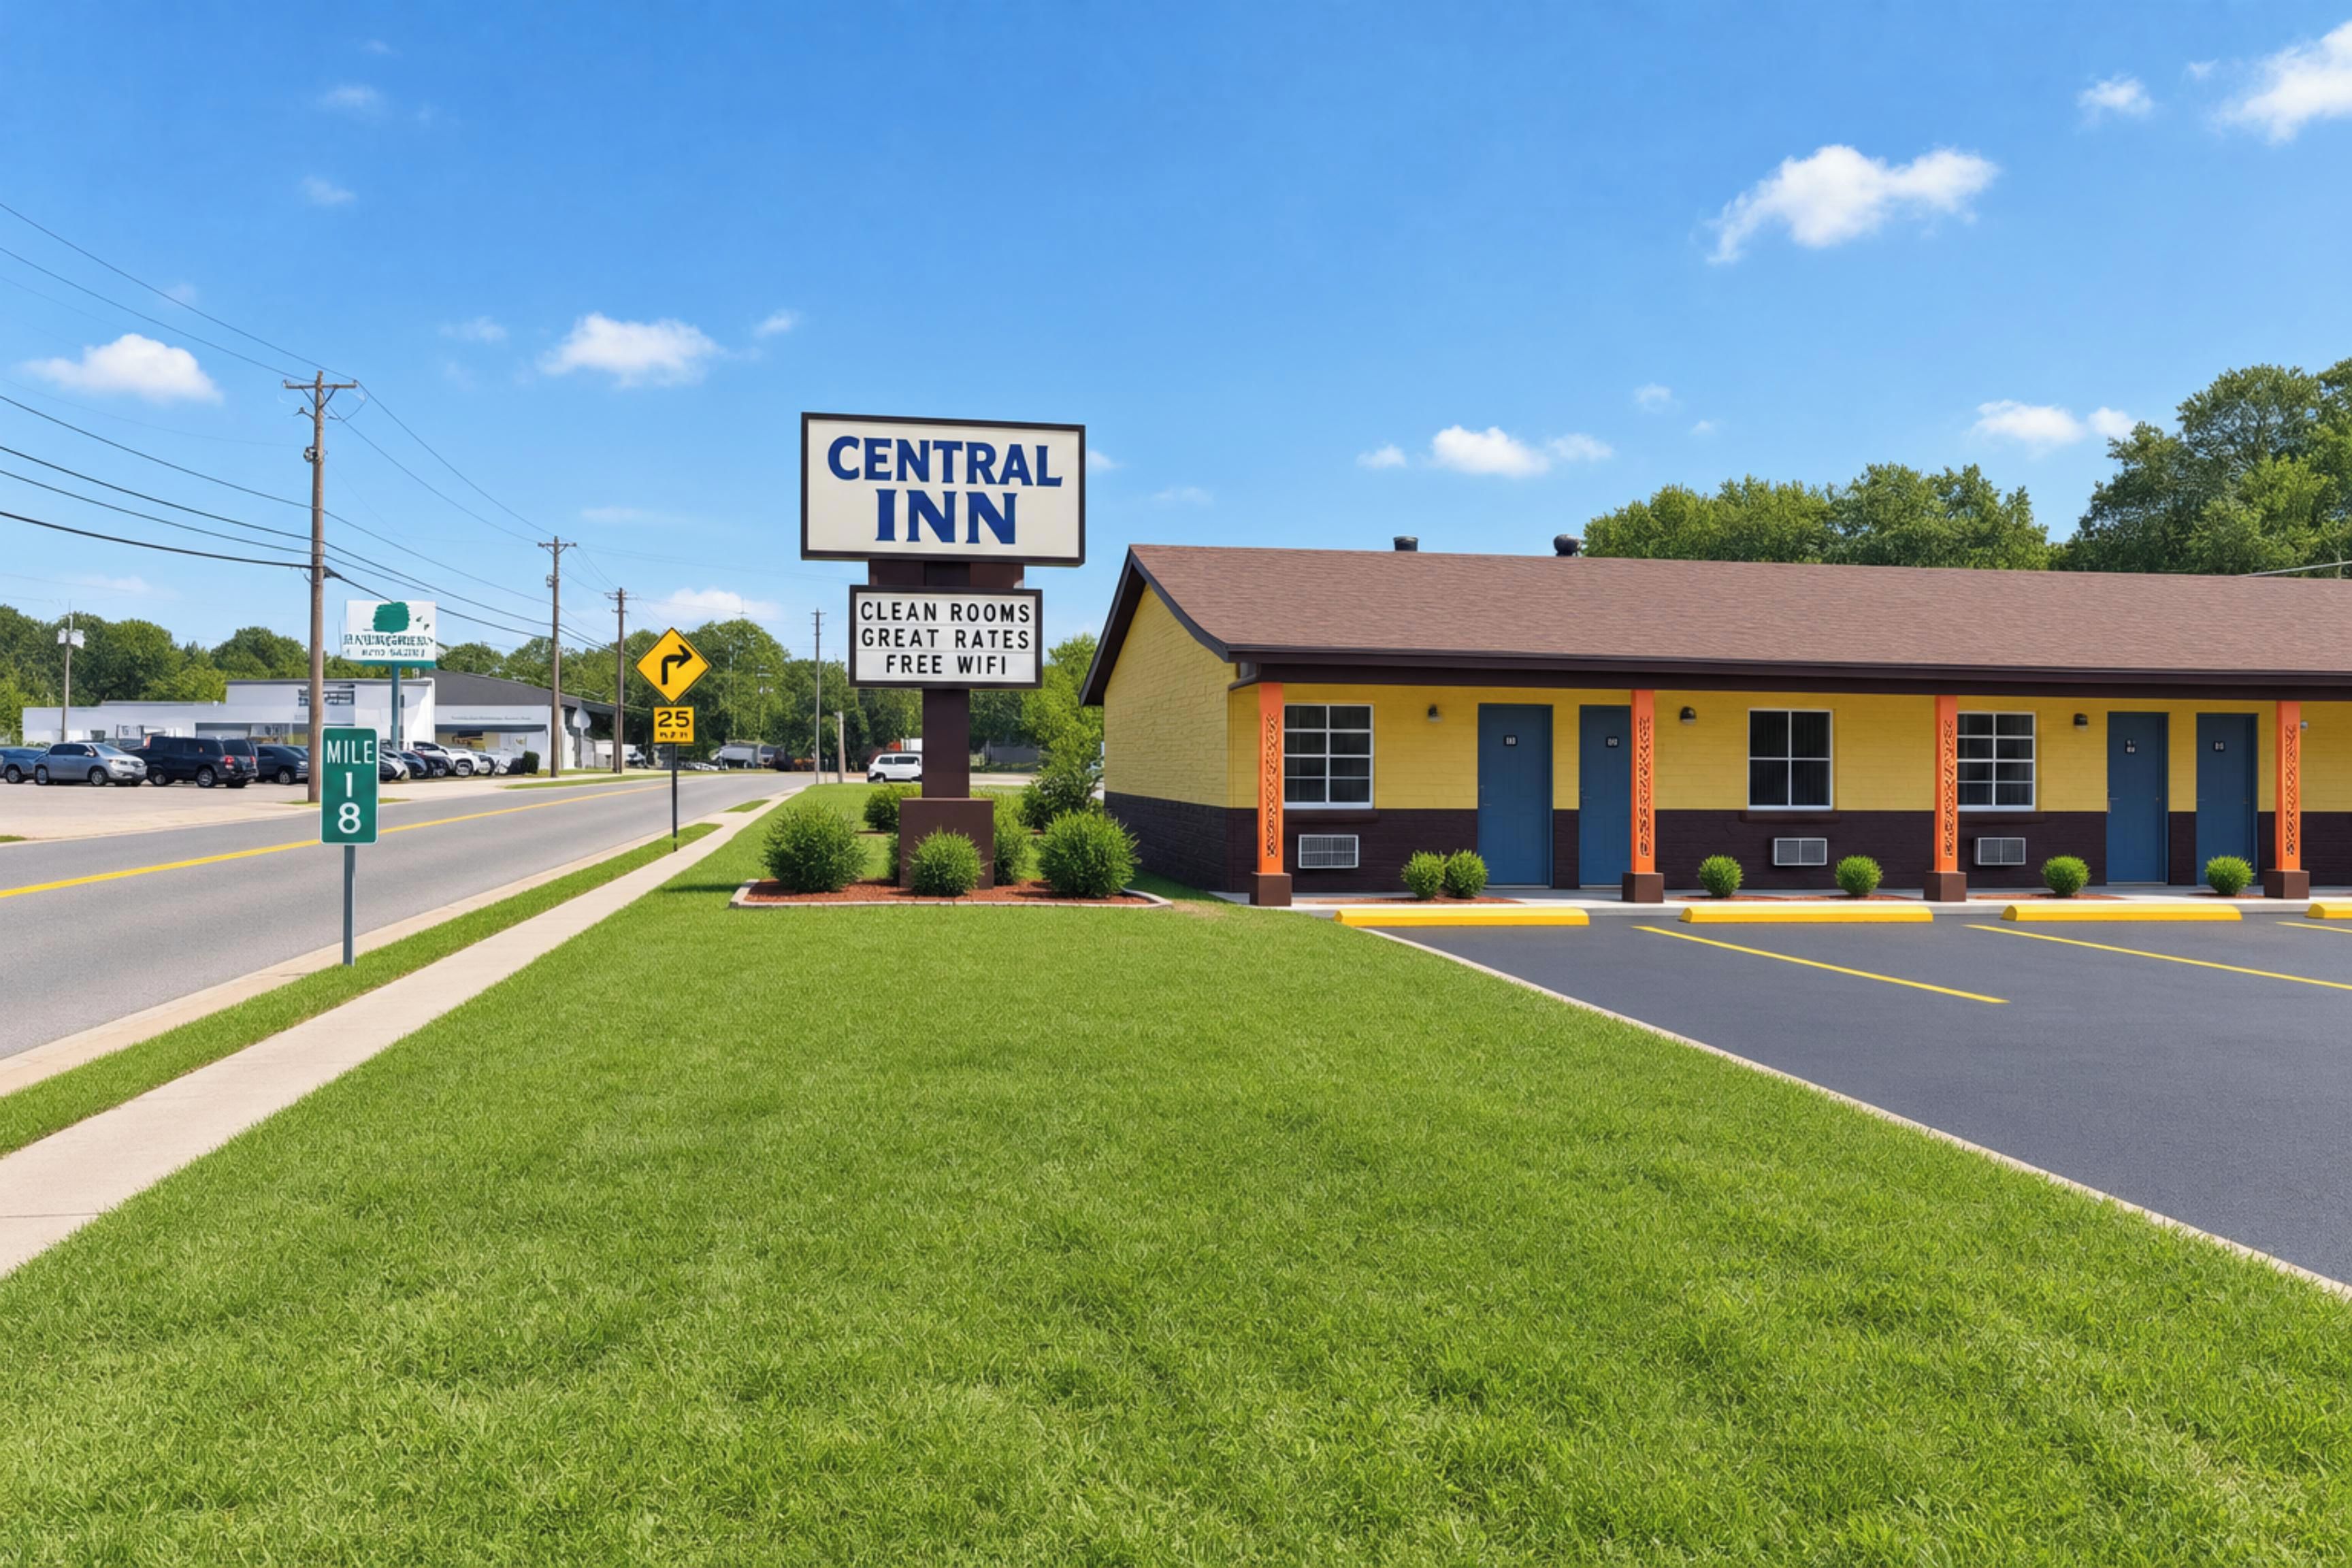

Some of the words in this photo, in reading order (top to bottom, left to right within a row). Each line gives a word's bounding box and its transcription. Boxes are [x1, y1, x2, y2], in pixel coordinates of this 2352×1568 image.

[828, 436, 1063, 487] CENTRAL
[875, 489, 1017, 545] INN
[860, 601, 936, 622] CLEAN
[950, 602, 1030, 623] ROOMS
[861, 627, 939, 648] GREAT
[955, 629, 1029, 650] RATES
[886, 654, 943, 675] FREE
[957, 655, 1006, 675] WIFI
[657, 710, 690, 728] 25
[327, 740, 374, 764] MILE
[345, 772, 353, 798] 1
[338, 802, 361, 834] 8
